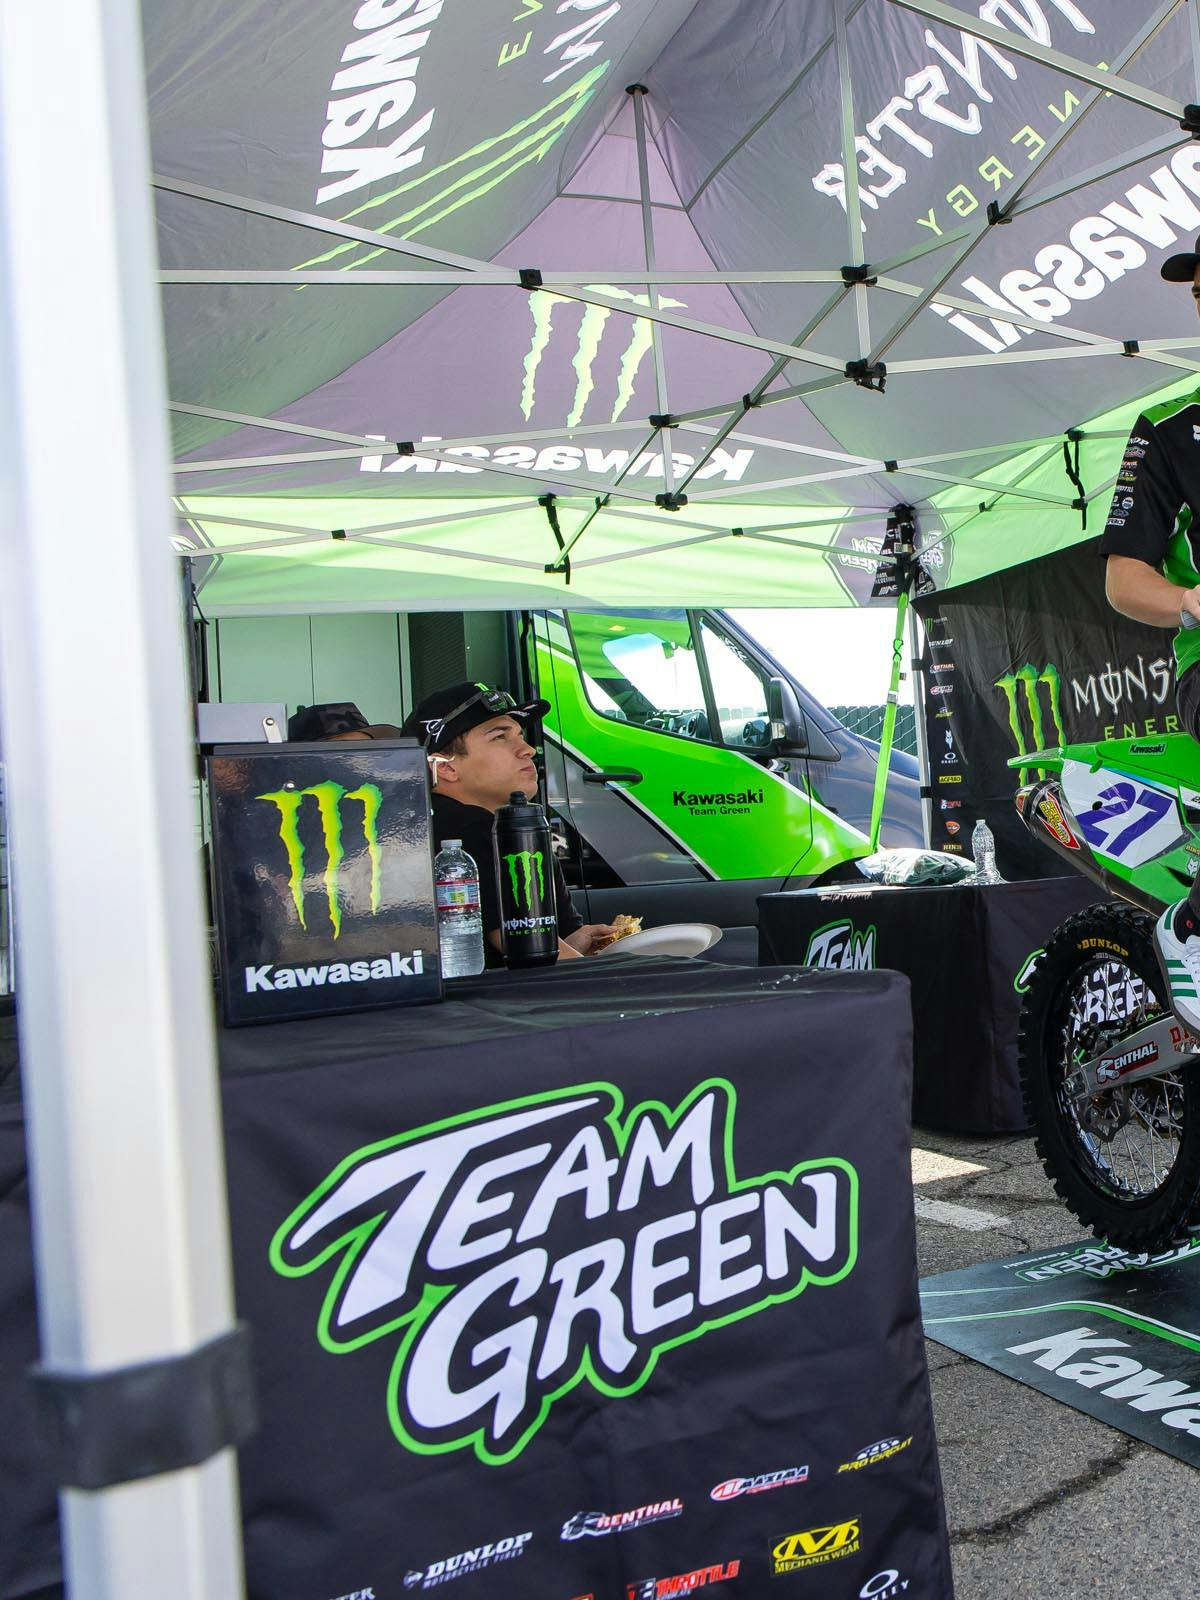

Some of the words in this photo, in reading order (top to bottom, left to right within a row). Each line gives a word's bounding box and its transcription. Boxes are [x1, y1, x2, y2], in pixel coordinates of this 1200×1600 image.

[1071, 654, 1174, 717] MONS
[1104, 715, 1179, 740] ENER
[1129, 744, 1166, 754] Kawasaki
[673, 789, 764, 806] Kawasaki
[689, 807, 717, 816] Team
[720, 806, 751, 815] Green
[1074, 782, 1174, 857] 27
[503, 915, 556, 930] MONSTER
[806, 926, 874, 970] TEAM
[1081, 938, 1129, 957] DUNLOP
[245, 950, 424, 993] Kawasaki
[1097, 1041, 1159, 1084] RENTHAL
[291, 1093, 714, 1326] TEAM
[1024, 1246, 1130, 1280] REEN
[405, 1171, 838, 1440] GREEN
[837, 1459, 869, 1474] PRO
[870, 1436, 913, 1464] CIRCUIT
[597, 1498, 683, 1528] RENTHAL
[424, 1532, 533, 1580] DUNLOP
[775, 1555, 831, 1574] MECHANIX
[831, 1540, 860, 1561] WEAR
[656, 1560, 740, 1597] THROTTLE
